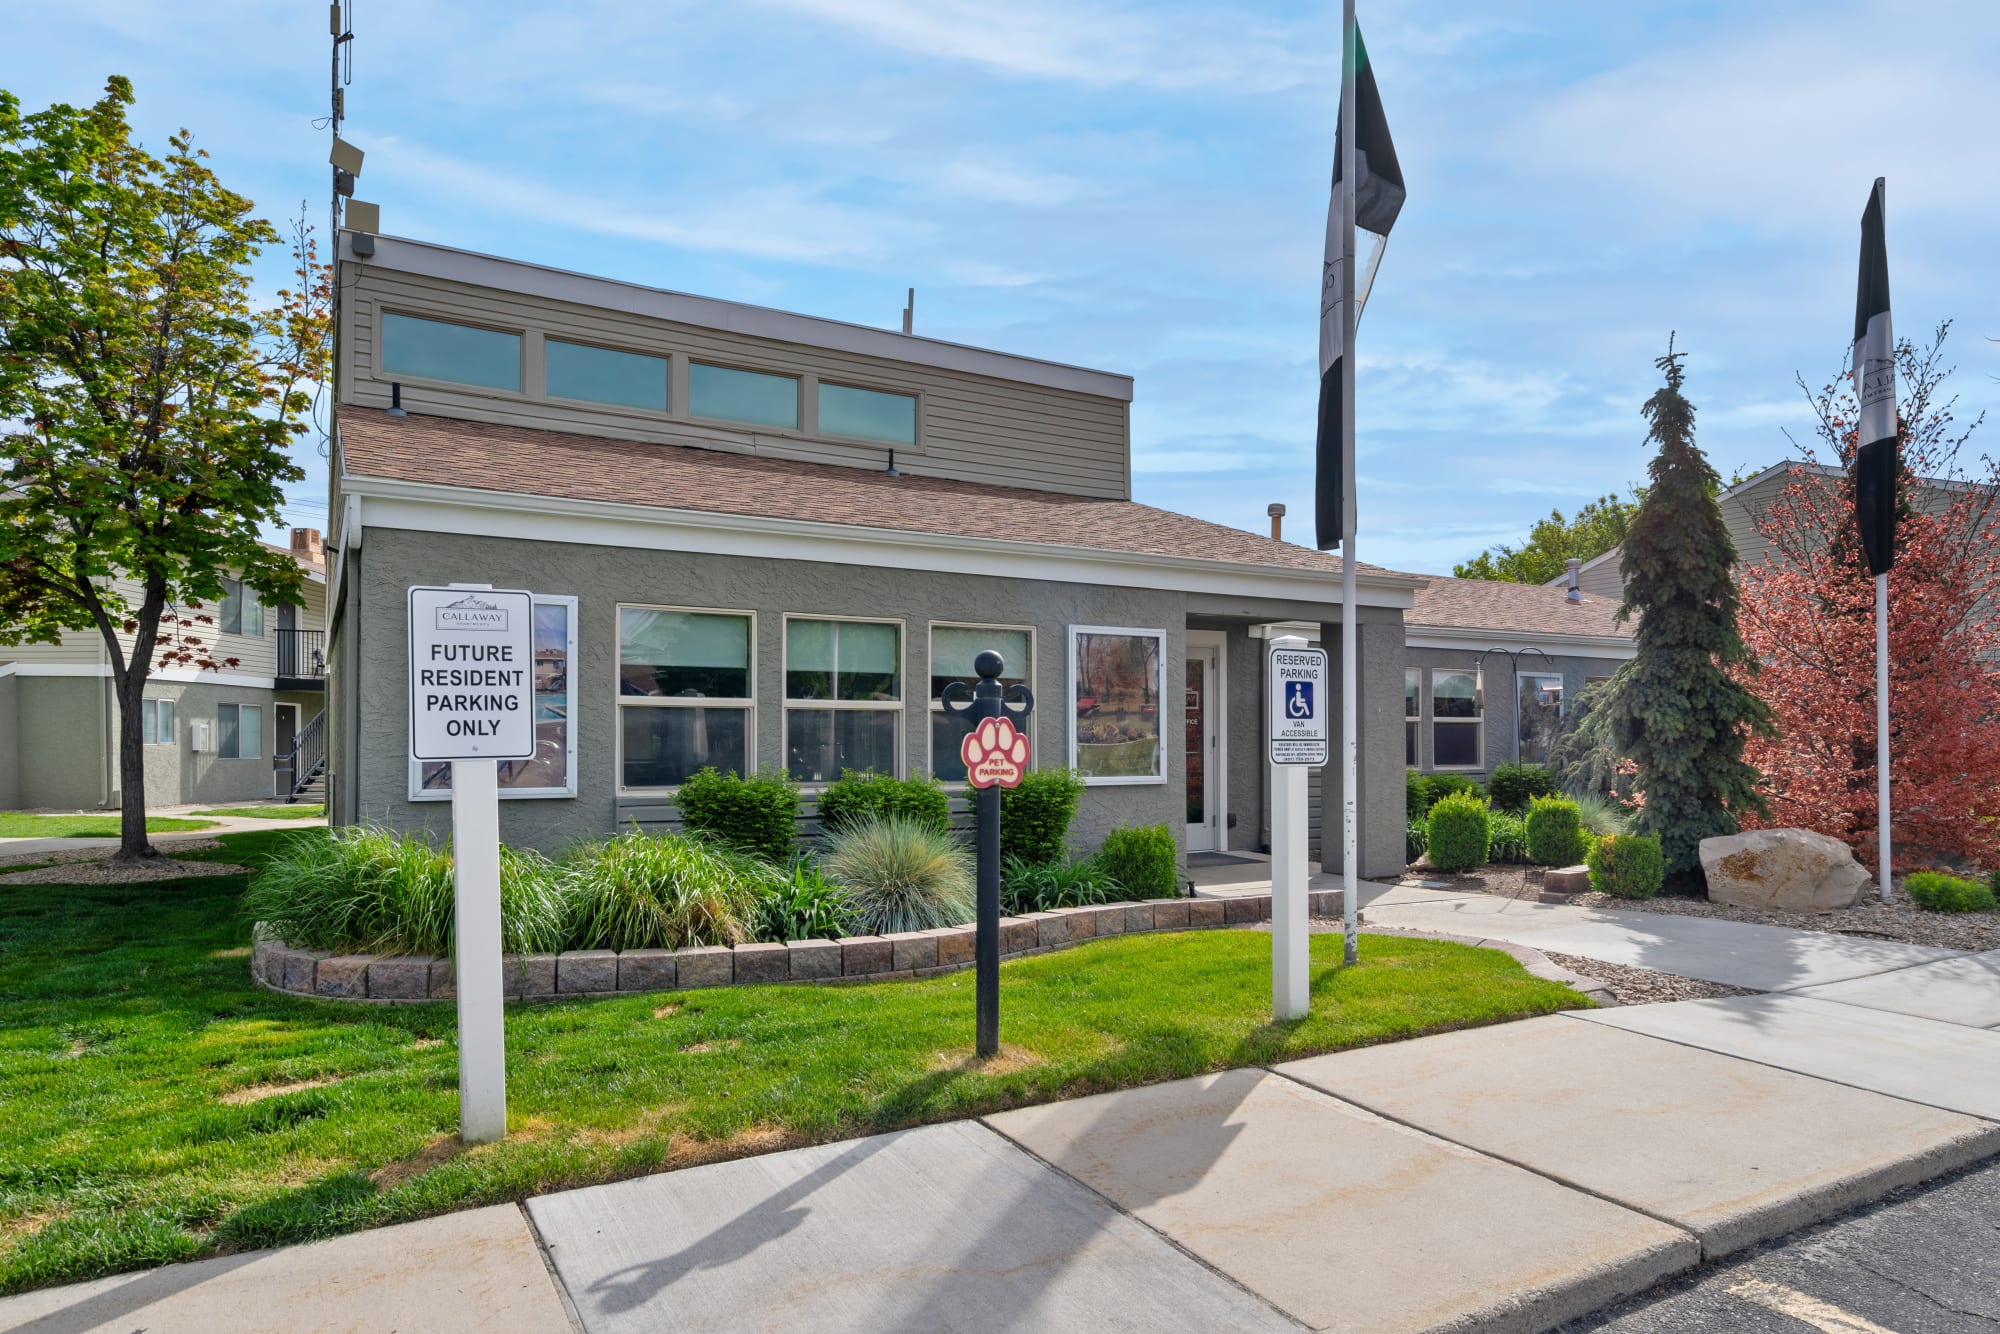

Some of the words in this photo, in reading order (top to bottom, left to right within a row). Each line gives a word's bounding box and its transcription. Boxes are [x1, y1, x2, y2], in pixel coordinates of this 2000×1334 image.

[442, 612, 503, 622] CALLAWAY
[431, 644, 513, 662] FUTURE
[1276, 654, 1322, 667] RESERVED
[421, 669, 524, 686] RESIDENT
[1280, 668, 1318, 679] PARKING
[427, 695, 519, 711] PARKING
[446, 719, 501, 736] ONLY
[1281, 729, 1318, 737] ACCESSIBLE
[989, 758, 1005, 767] PET
[979, 768, 1014, 776] PARKING
